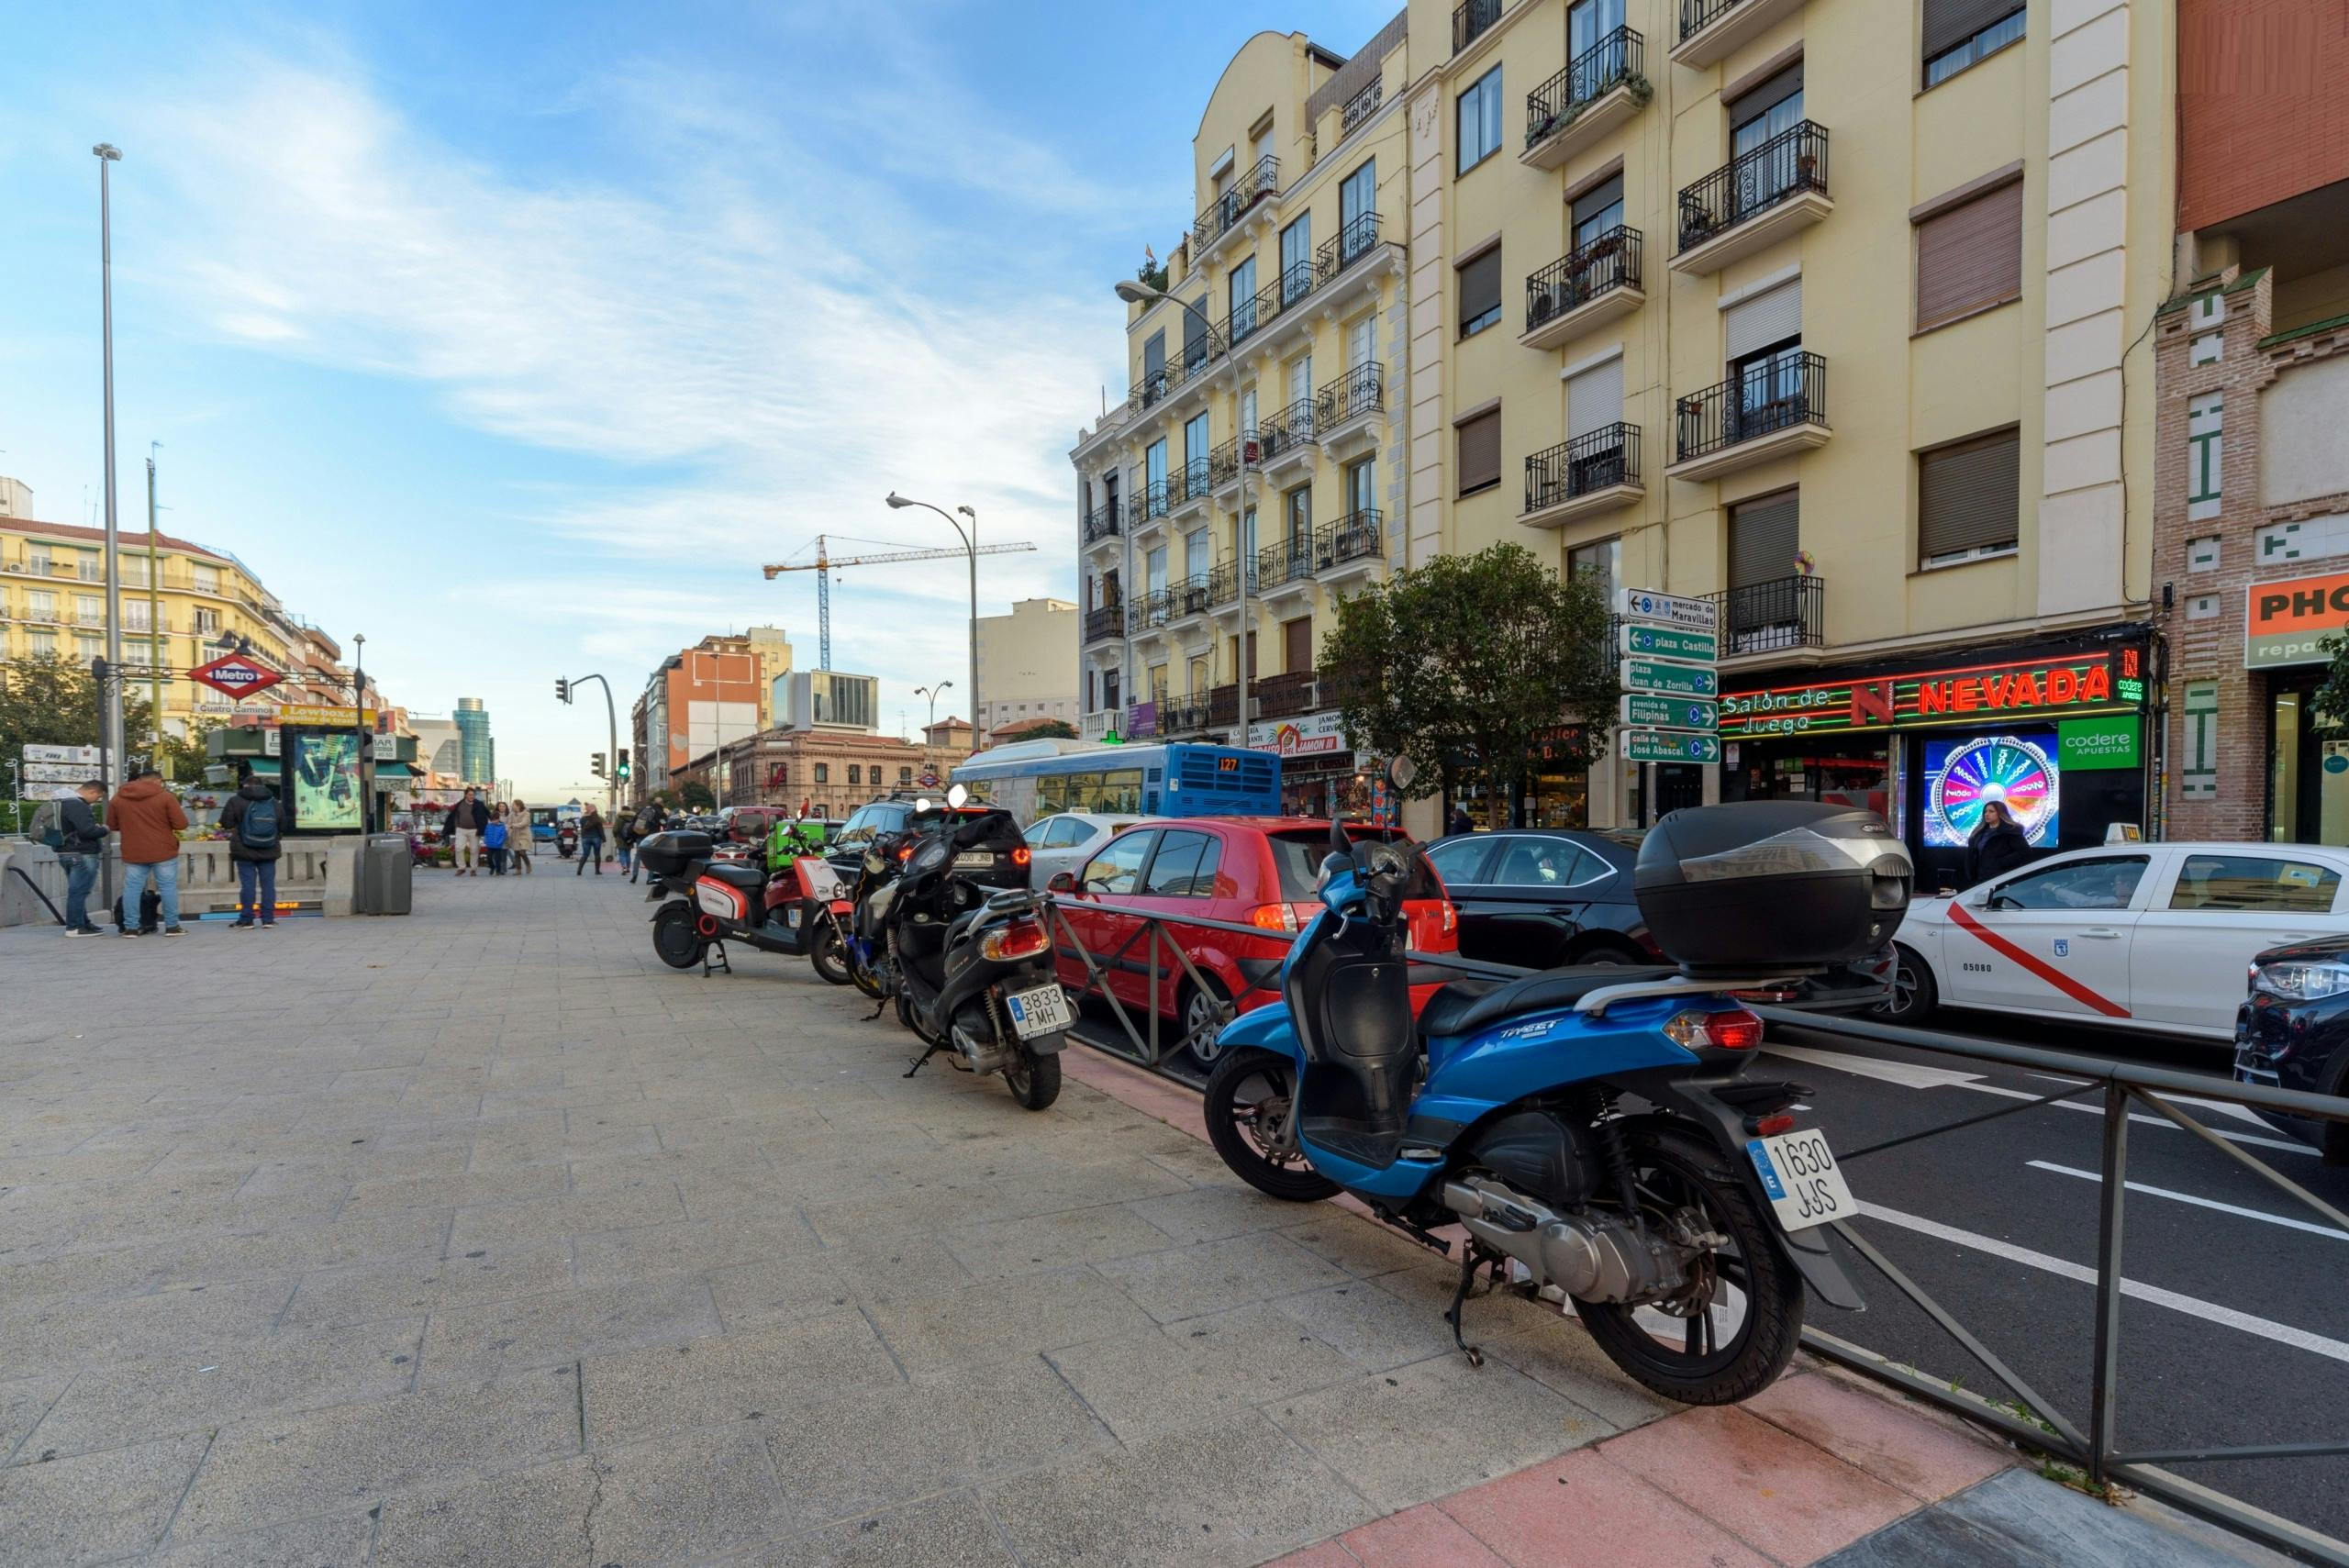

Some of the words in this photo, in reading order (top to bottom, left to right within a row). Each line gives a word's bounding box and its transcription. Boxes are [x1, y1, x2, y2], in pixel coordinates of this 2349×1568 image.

[1672, 601, 1702, 612] mercado
[1705, 606, 1714, 614] de
[1671, 610, 1714, 625] Maravillas
[1655, 637, 1678, 648] plaza
[1682, 639, 1715, 653] Castilla
[1630, 663, 1652, 674] plaza
[2123, 650, 2138, 678] N
[215, 670, 255, 682] Metro
[1631, 676, 1649, 686] Juan
[1653, 679, 1663, 688] de
[1666, 680, 1694, 691] Zorrilla
[1919, 664, 2109, 715] NEVADA
[1632, 700, 1658, 709] avenida
[1726, 693, 1788, 713] Salón
[1799, 688, 1828, 706] de
[200, 705, 231, 714] Cuatro
[234, 705, 274, 715] Caminos
[1632, 708, 1670, 722] Filipinas
[1742, 717, 1809, 736] Juego
[1632, 734, 1649, 743] calle
[1650, 735, 1659, 743] de
[2065, 733, 2131, 748] codere
[1297, 740, 1324, 752] JAMON
[1632, 744, 1651, 754] José
[1653, 745, 1684, 756] Abascal
[2076, 745, 2132, 755] APUESTAS
[1219, 758, 1238, 771] 127
[1963, 963, 1992, 973] 05080
[1022, 988, 1061, 1011] 3833
[1027, 1006, 1057, 1029] FMH
[1775, 1138, 1832, 1180] 1630
[1766, 1175, 1777, 1189] E
[1796, 1178, 1837, 1218] JJS
